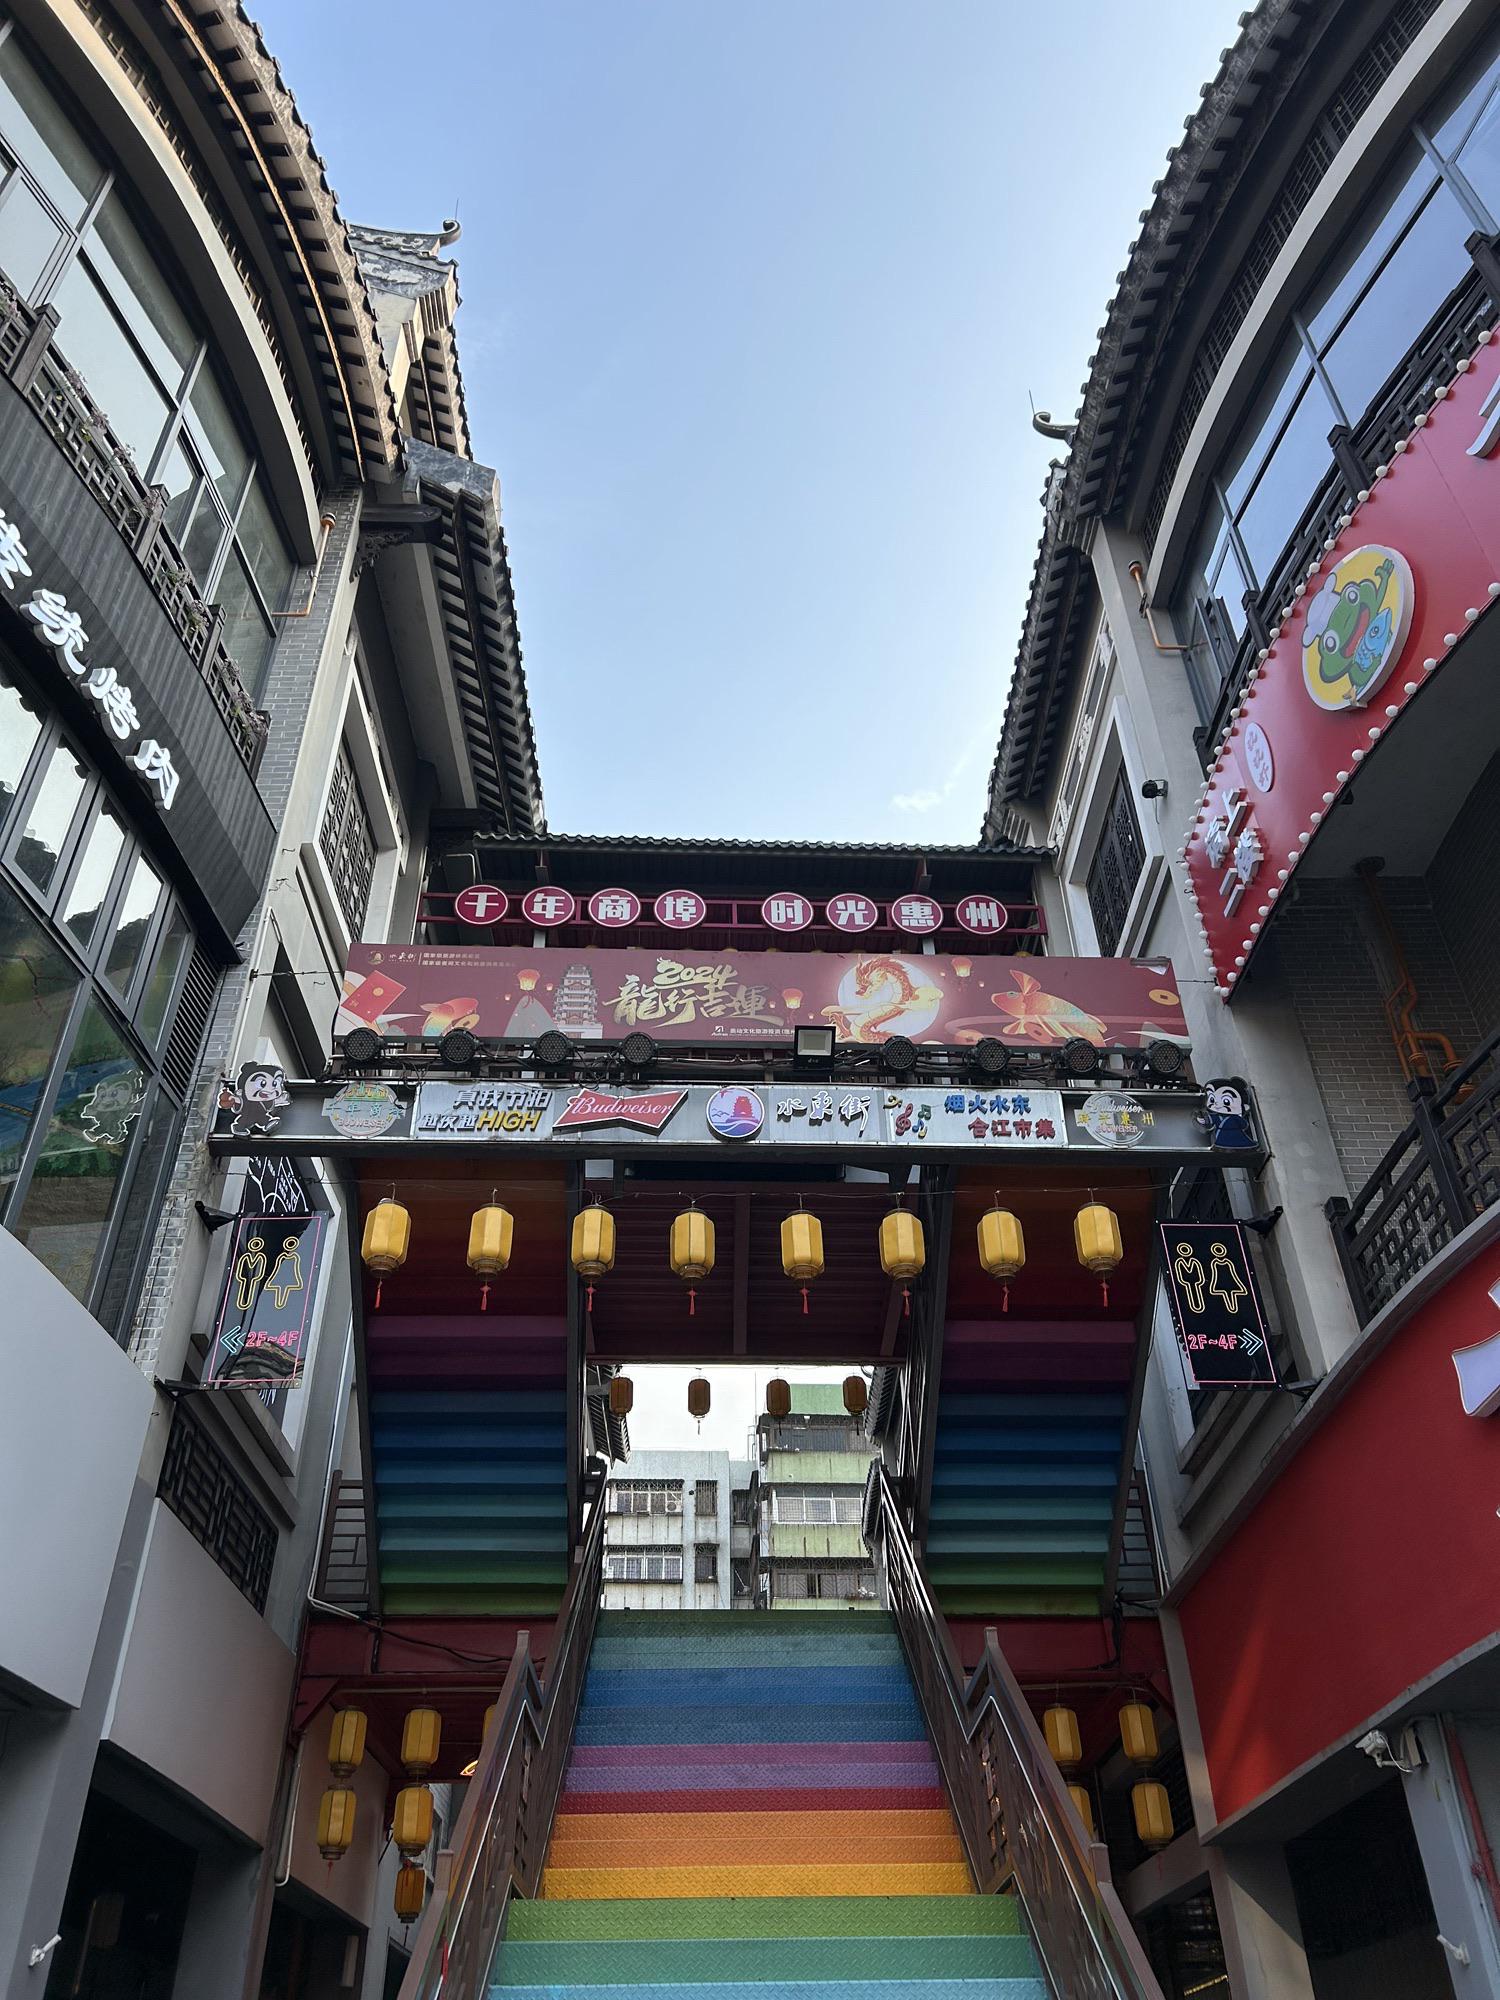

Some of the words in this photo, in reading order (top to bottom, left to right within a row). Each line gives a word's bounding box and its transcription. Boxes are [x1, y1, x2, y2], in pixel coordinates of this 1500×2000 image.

[464, 891, 698, 922] 千年商埠
[770, 899, 1000, 928] 时光惠州
[653, 957, 738, 988] 2024
[567, 1095, 672, 1116] Budweiser
[944, 1094, 1031, 1115] 烟火水东
[968, 1117, 1056, 1140] 合江市集
[1188, 1334, 1238, 1350] 2F~4F
